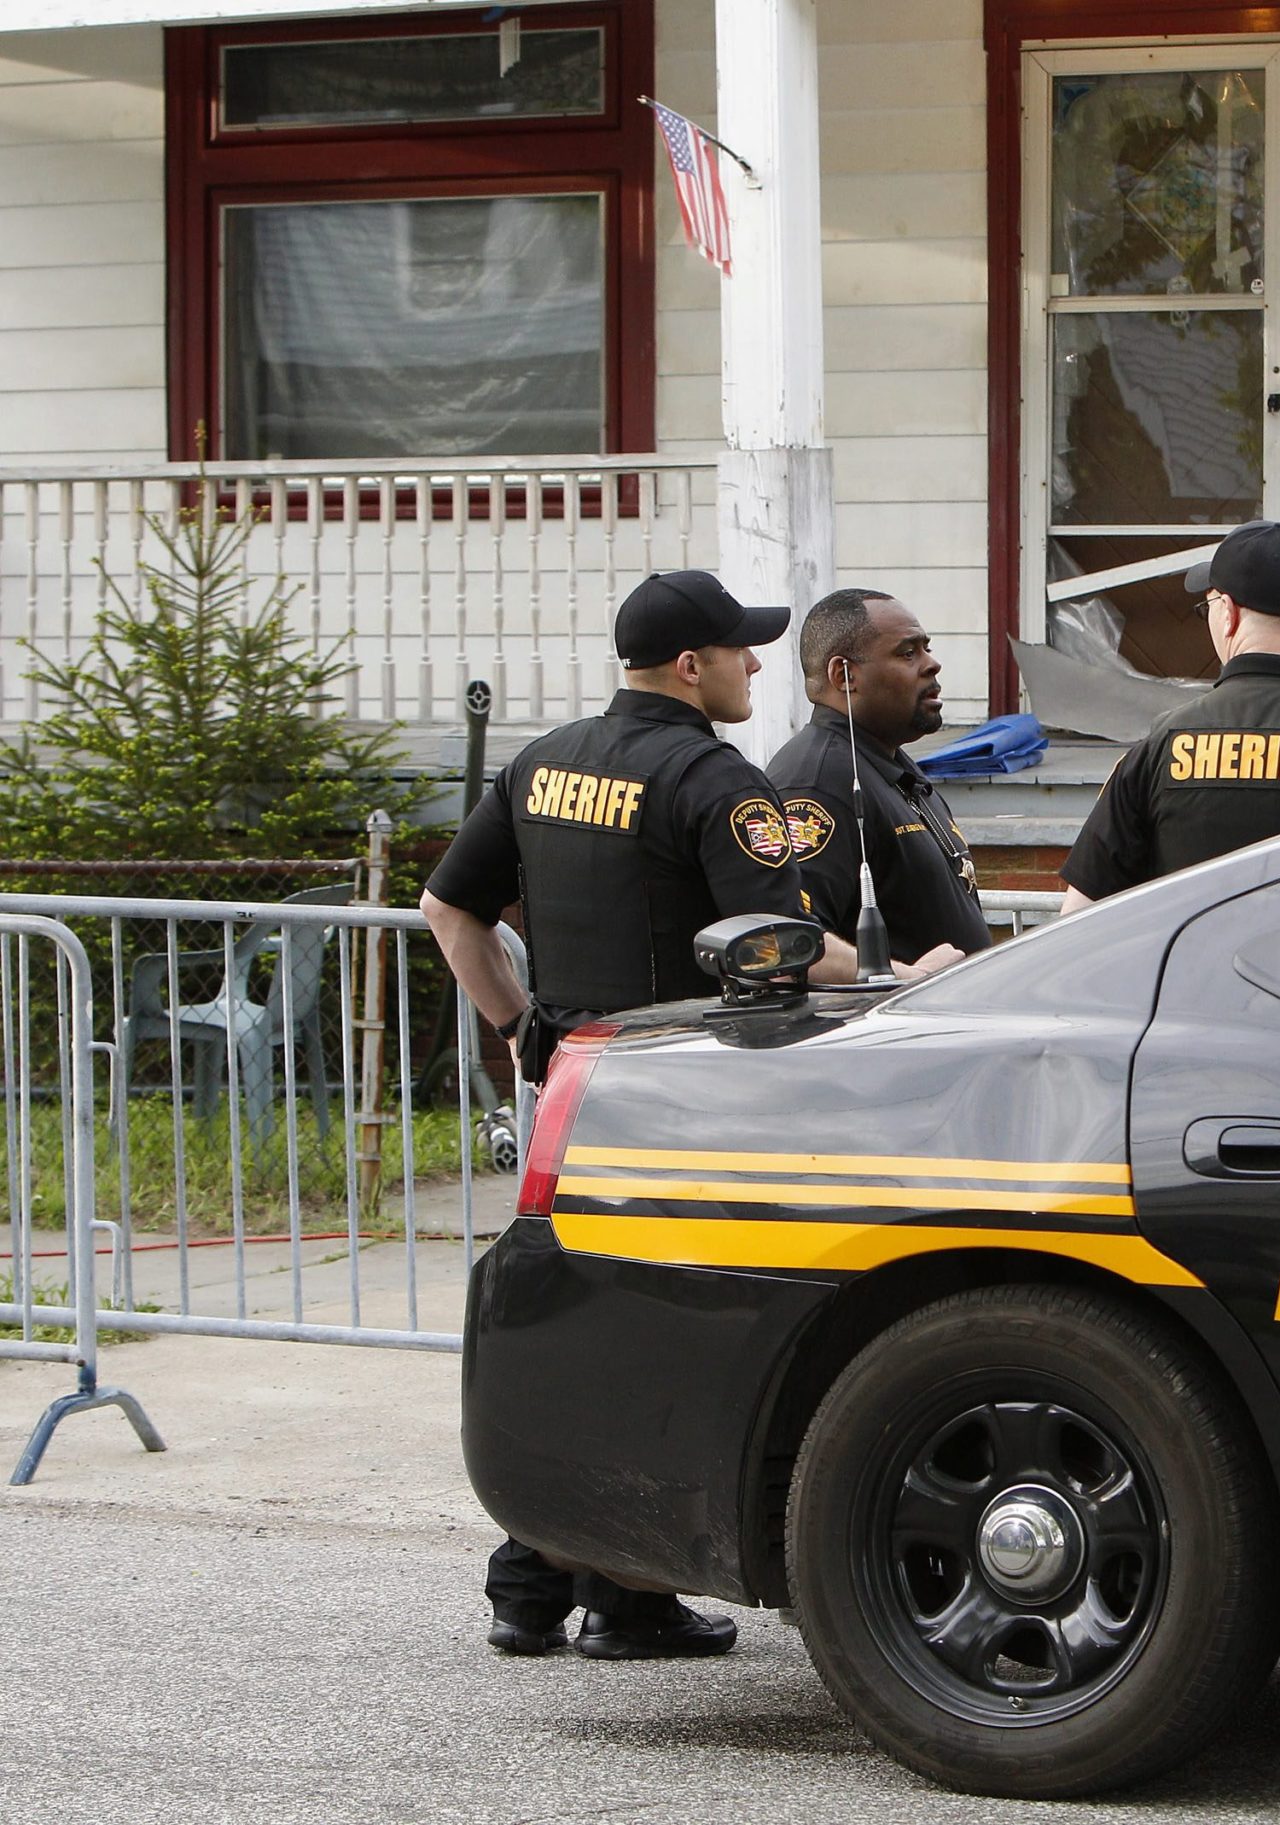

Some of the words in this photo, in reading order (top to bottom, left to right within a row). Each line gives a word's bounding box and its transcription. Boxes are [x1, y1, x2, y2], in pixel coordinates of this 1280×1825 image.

[527, 767, 645, 830] SHERIFF
[735, 804, 758, 824] DEPUTY
[785, 803, 805, 814] PUTY
[806, 805, 832, 826] SHERIFF
